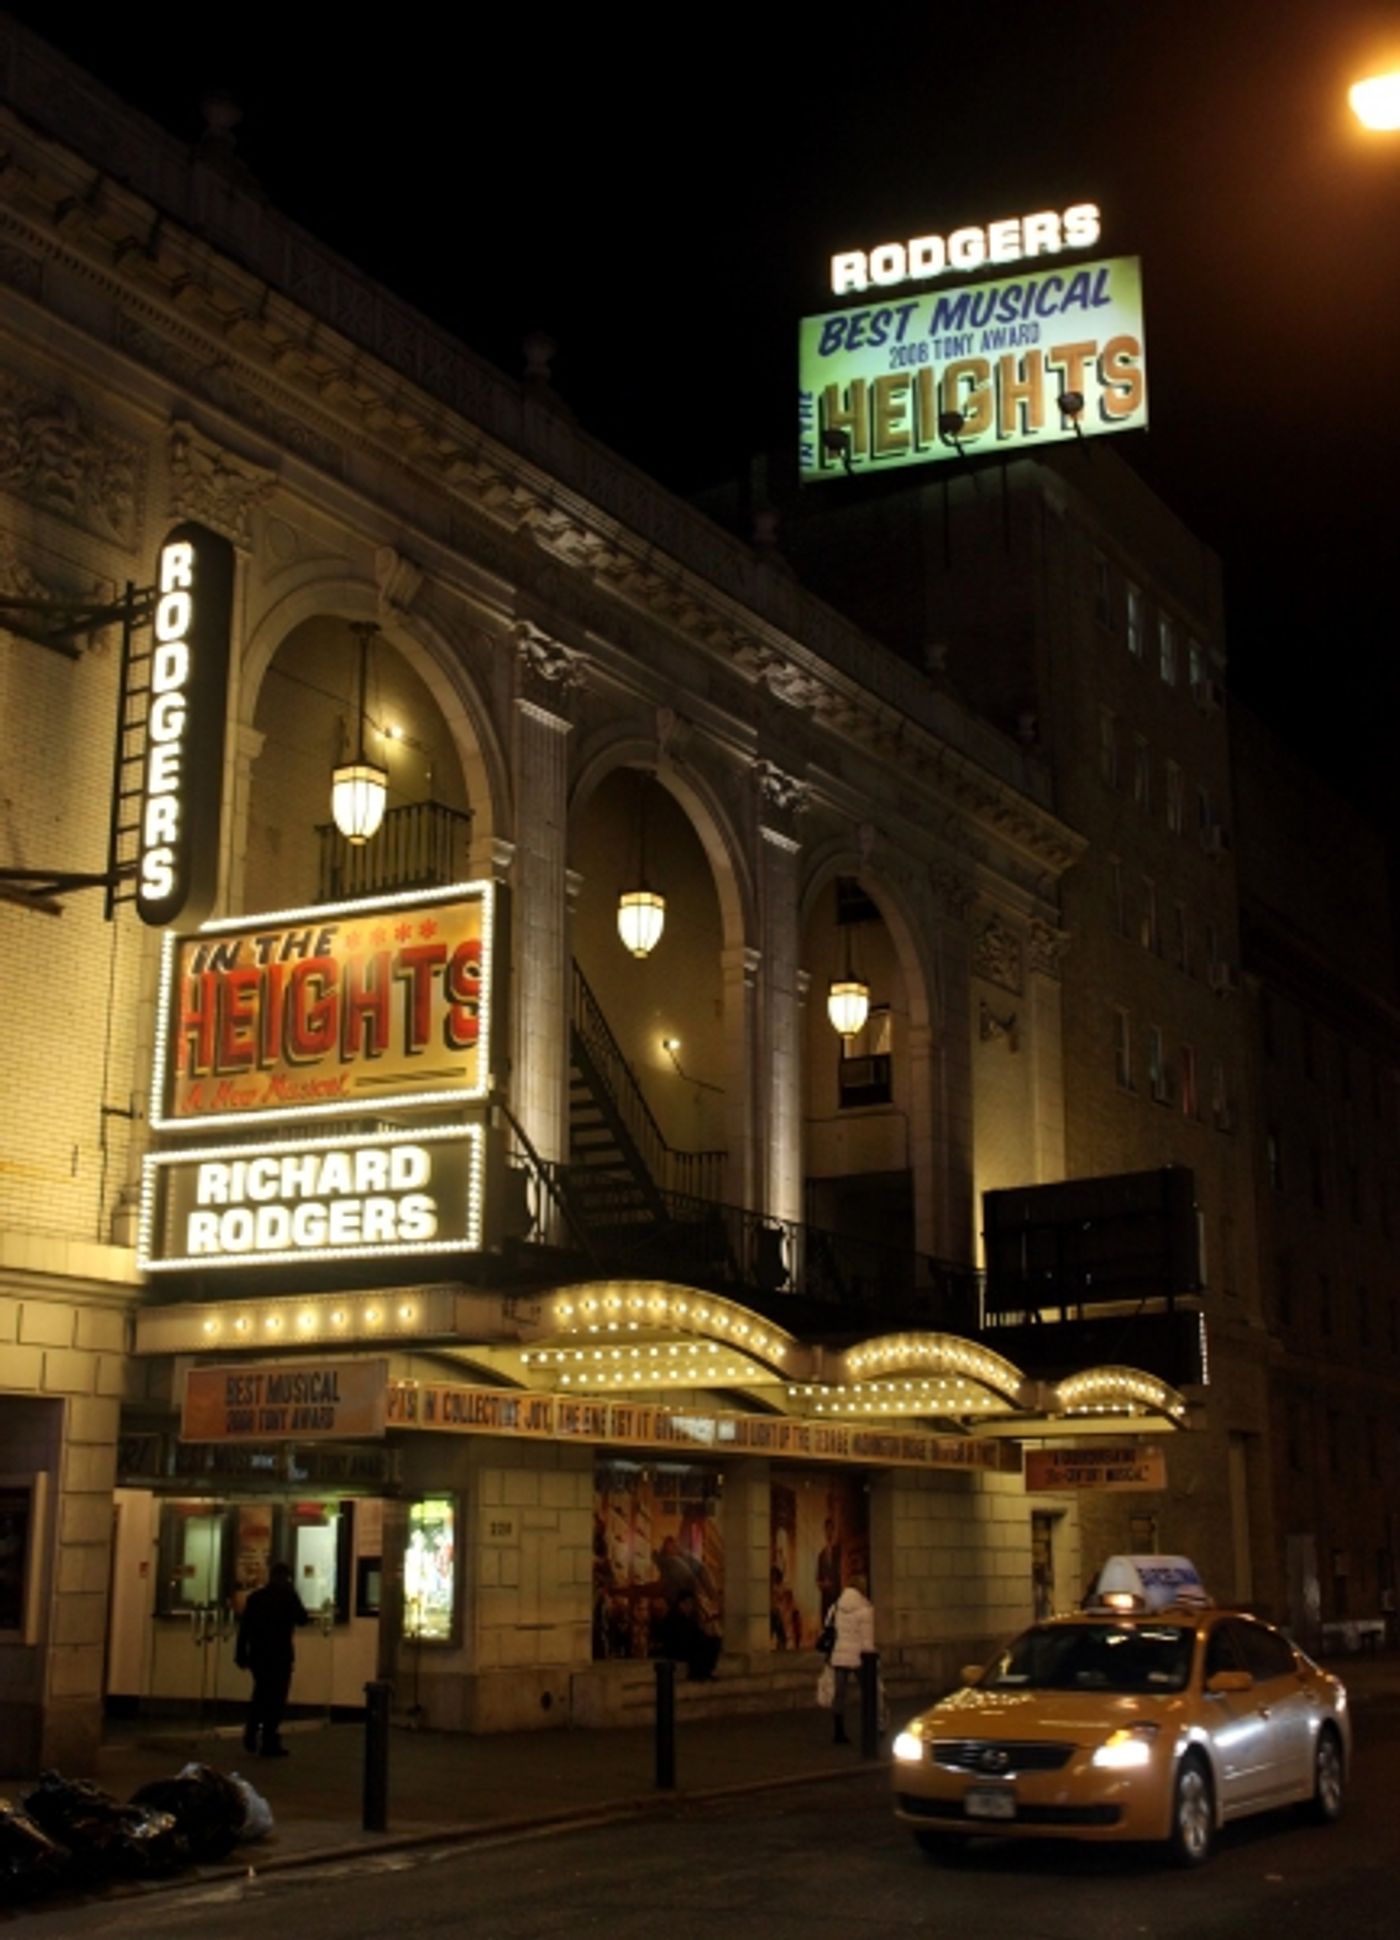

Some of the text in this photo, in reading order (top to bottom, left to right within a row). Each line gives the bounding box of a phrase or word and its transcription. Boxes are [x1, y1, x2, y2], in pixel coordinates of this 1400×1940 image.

[831, 203, 1101, 295] RODGERS
[817, 268, 1111, 357] BEST MUSICAL
[934, 333, 973, 366] TONY
[980, 322, 1040, 354] AWARD
[817, 335, 1143, 471] HEIGHTS
[140, 541, 195, 901] RODGERS
[190, 924, 339, 976] IN THE
[178, 939, 481, 1079] HEIGHTS
[196, 1145, 431, 1205] RICHARD
[186, 1193, 438, 1256] RODGERS
[226, 1370, 340, 1406] BEST MUSICAL
